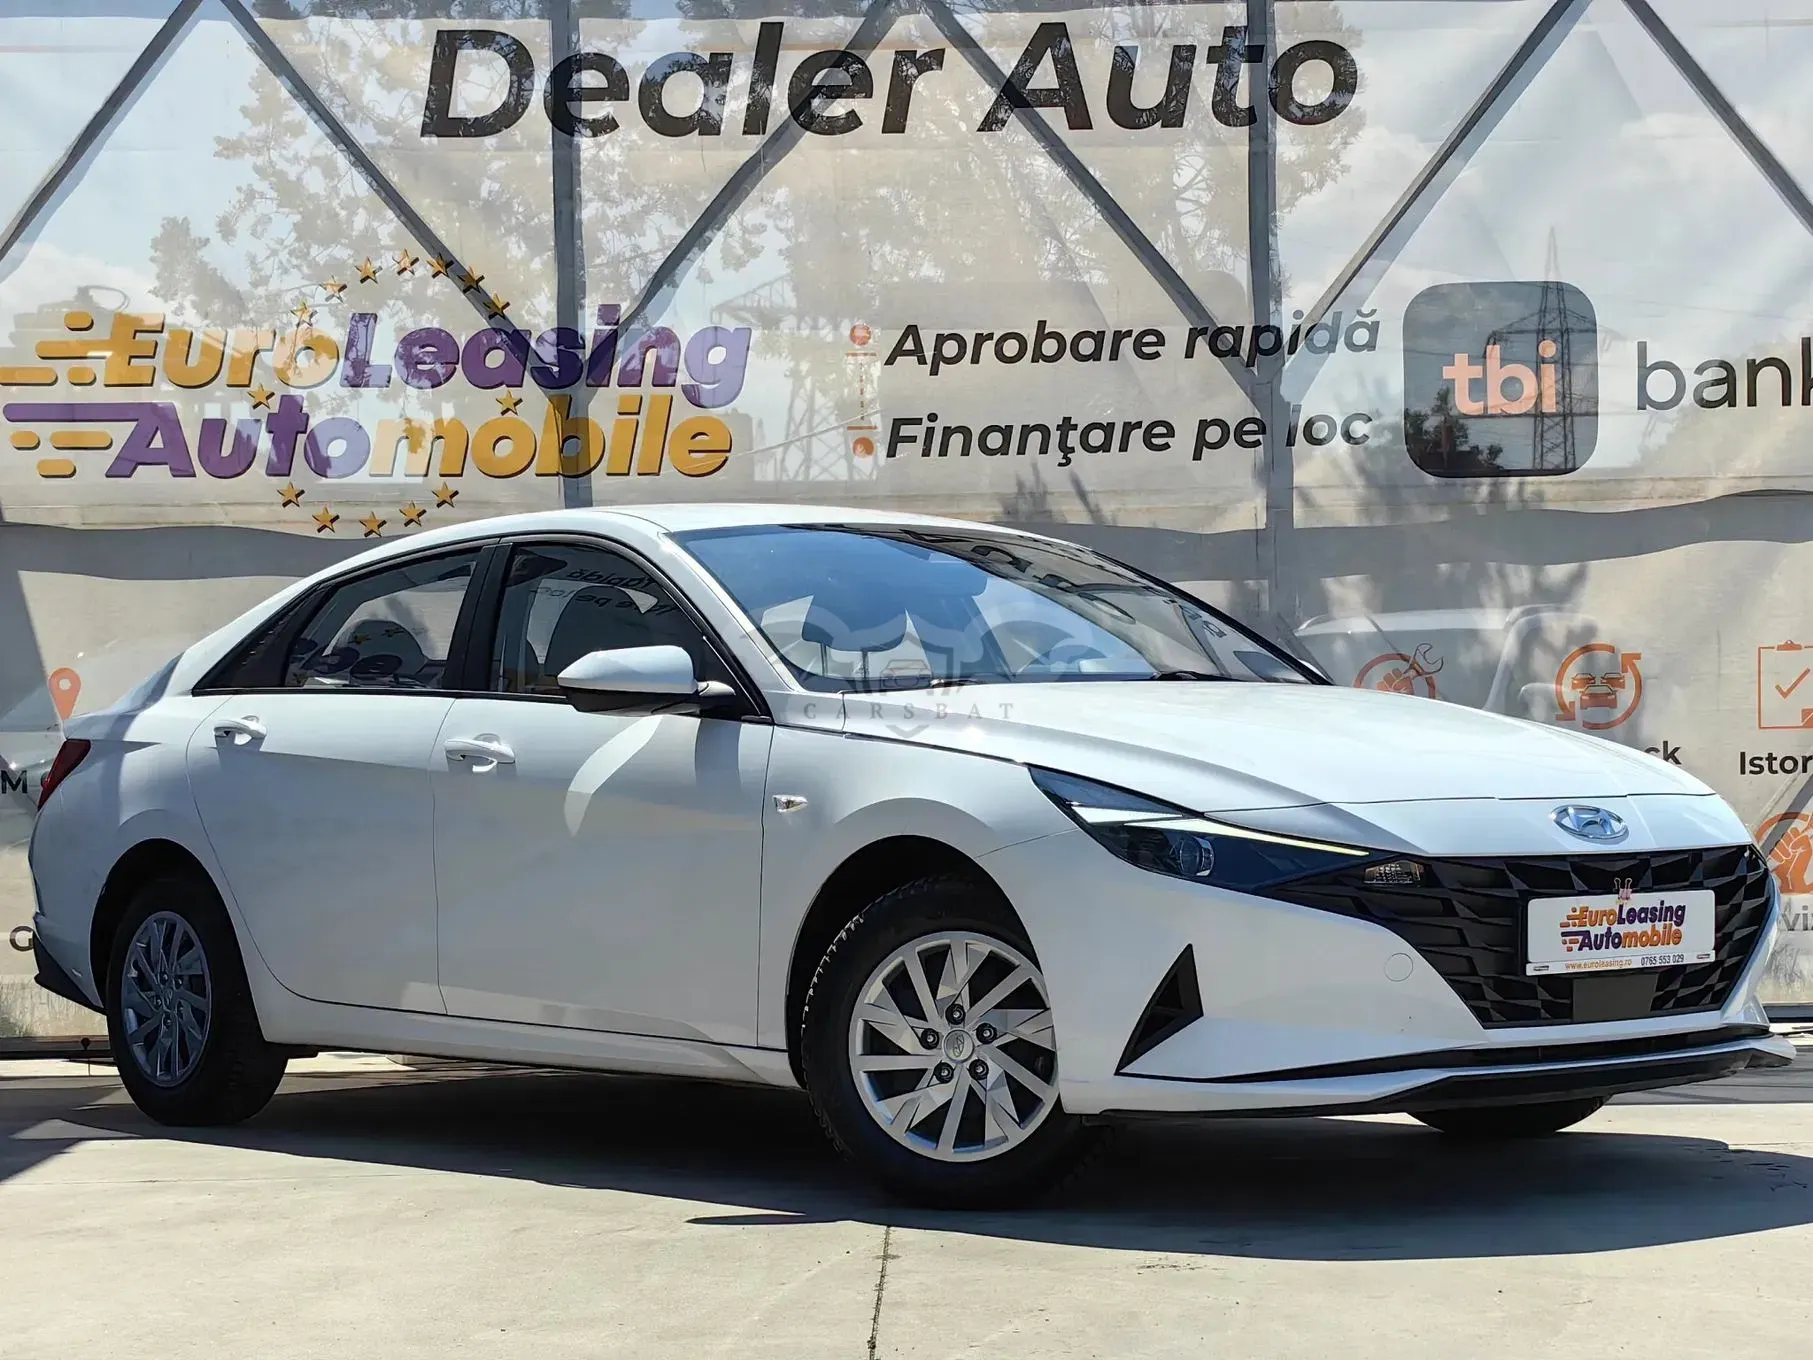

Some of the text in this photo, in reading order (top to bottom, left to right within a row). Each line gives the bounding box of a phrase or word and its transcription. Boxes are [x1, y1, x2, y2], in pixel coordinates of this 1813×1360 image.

[420, 22, 1359, 138] Dealer Auto
[103, 304, 753, 407] EuroLeasing
[884, 309, 1379, 376] Aprobare rapidă
[1442, 339, 1557, 415] tbi
[105, 394, 735, 478] Automobile
[1192, 415, 1268, 460] pe
[1285, 405, 1374, 448] loc
[1578, 900, 1686, 927] EuroLeasing
[1578, 922, 1683, 951] Automobile
[1565, 953, 1685, 970] www.euroleasing.ro 0765 553 029
